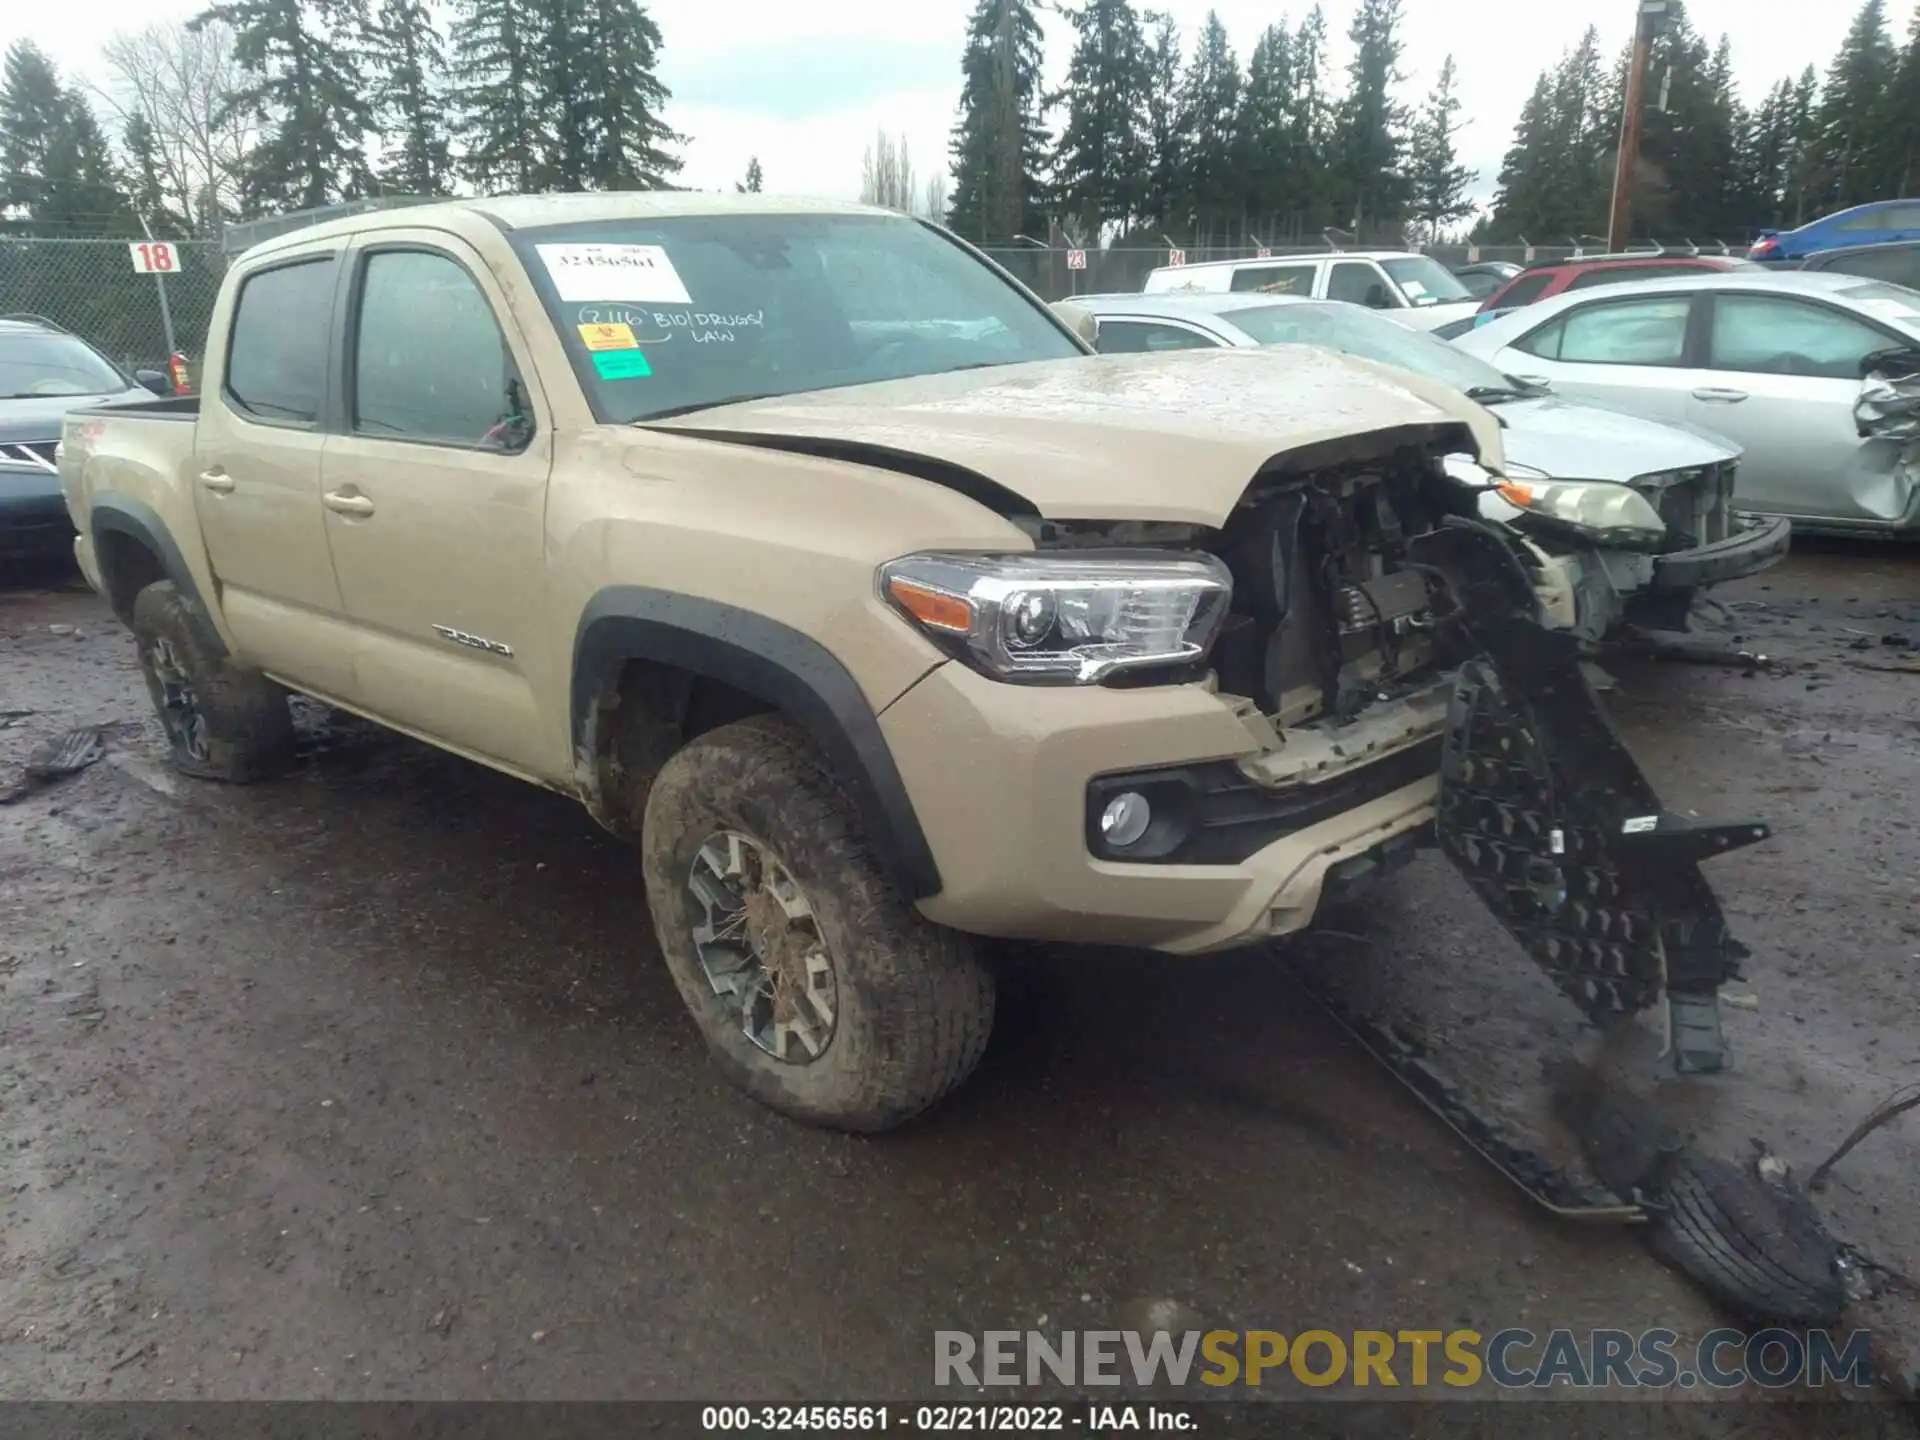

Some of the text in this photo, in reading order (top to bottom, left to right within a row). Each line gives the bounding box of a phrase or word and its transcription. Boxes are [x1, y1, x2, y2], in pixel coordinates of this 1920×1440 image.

[137, 243, 172, 271] 18
[560, 255, 655, 269] 32456561
[1068, 251, 1085, 267] 23
[691, 330, 735, 343] LAW
